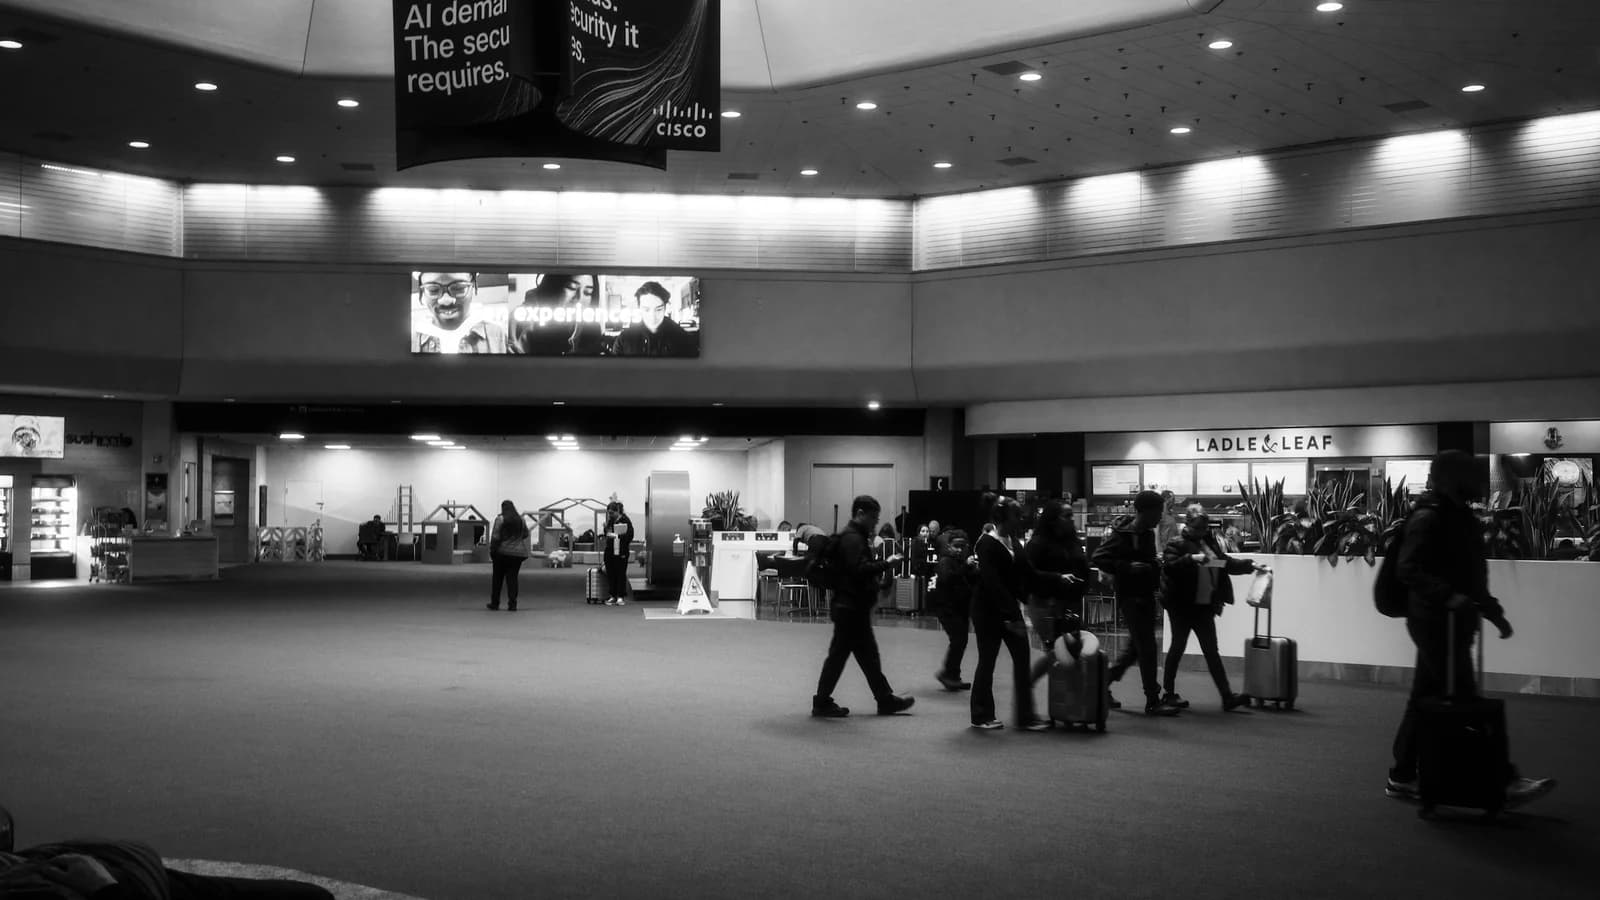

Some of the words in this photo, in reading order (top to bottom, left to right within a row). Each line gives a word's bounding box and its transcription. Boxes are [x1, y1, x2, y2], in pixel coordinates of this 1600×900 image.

[404, 3, 432, 30] AI
[404, 34, 455, 61] The
[624, 20, 640, 49] it
[407, 60, 510, 96] requires.
[657, 122, 706, 138] CISCO
[514, 303, 642, 326] experiences
[1196, 437, 1257, 452] LADLE
[1282, 435, 1332, 450] LEAF
